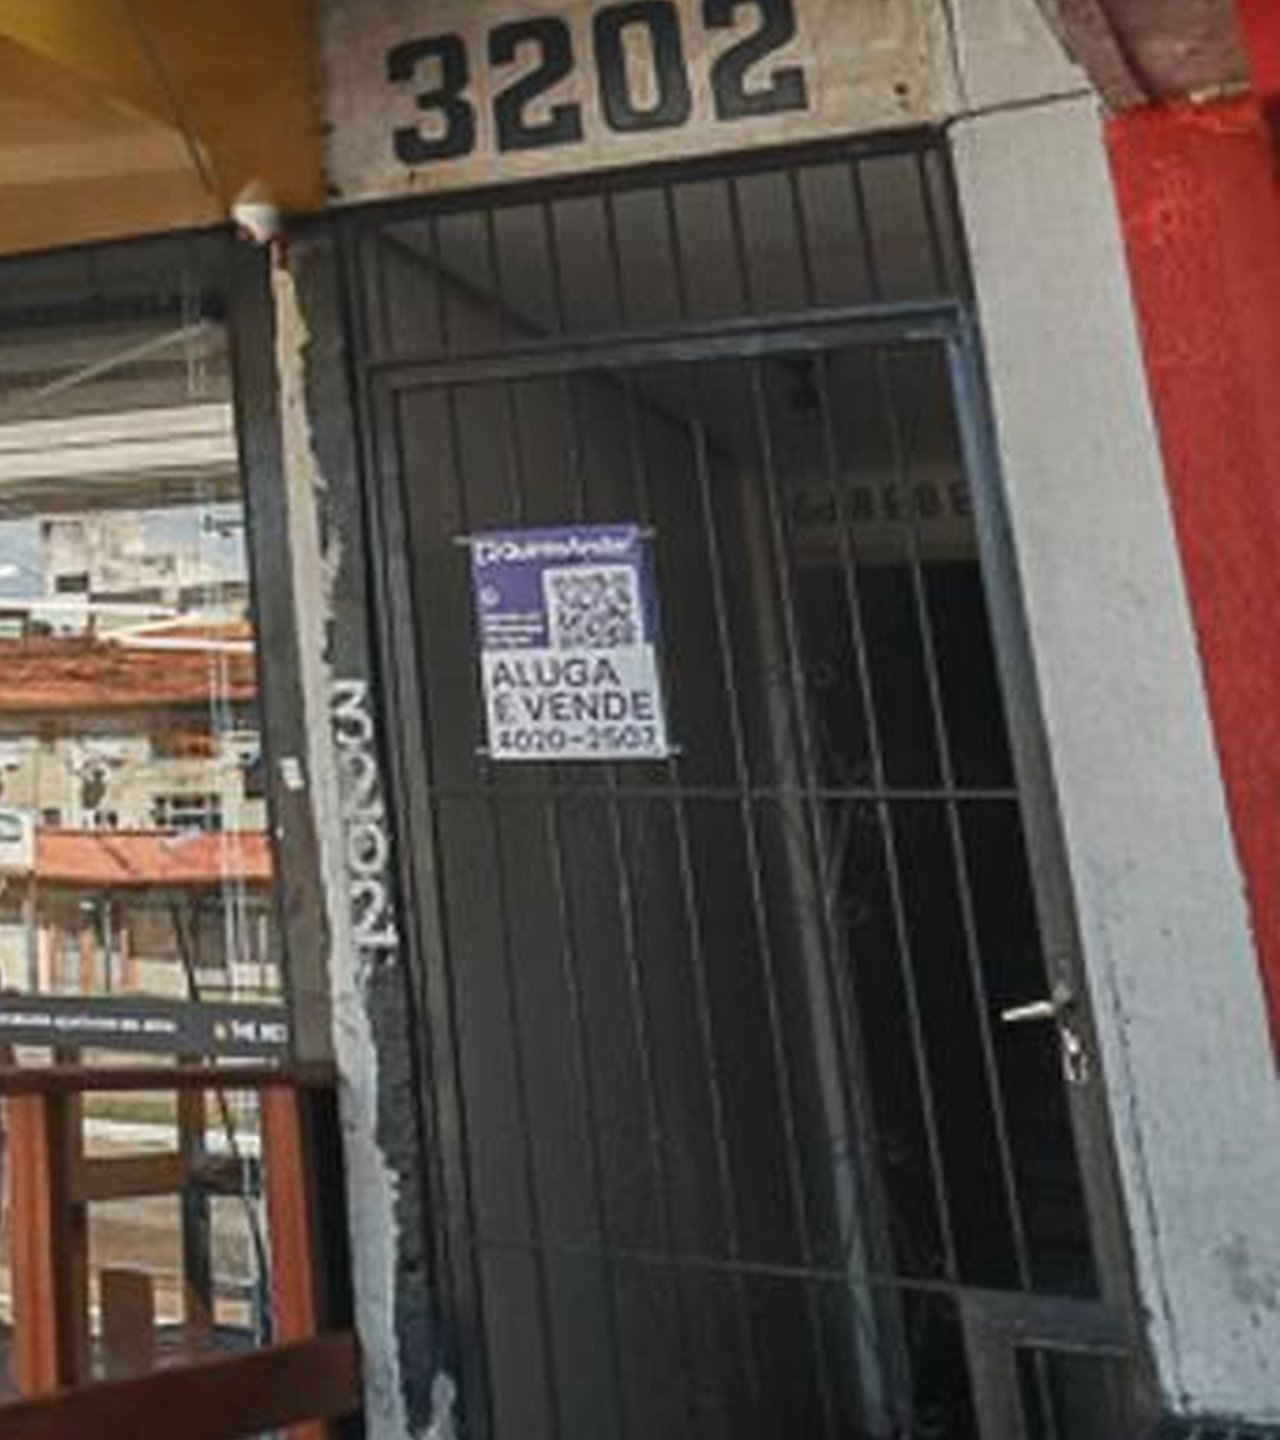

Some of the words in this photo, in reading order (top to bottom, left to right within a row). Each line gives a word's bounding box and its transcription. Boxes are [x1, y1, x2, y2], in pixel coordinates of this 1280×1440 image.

[491, 656, 622, 688] ALUGA
[522, 690, 656, 722] VENDE
[331, 678, 400, 950] 3202
